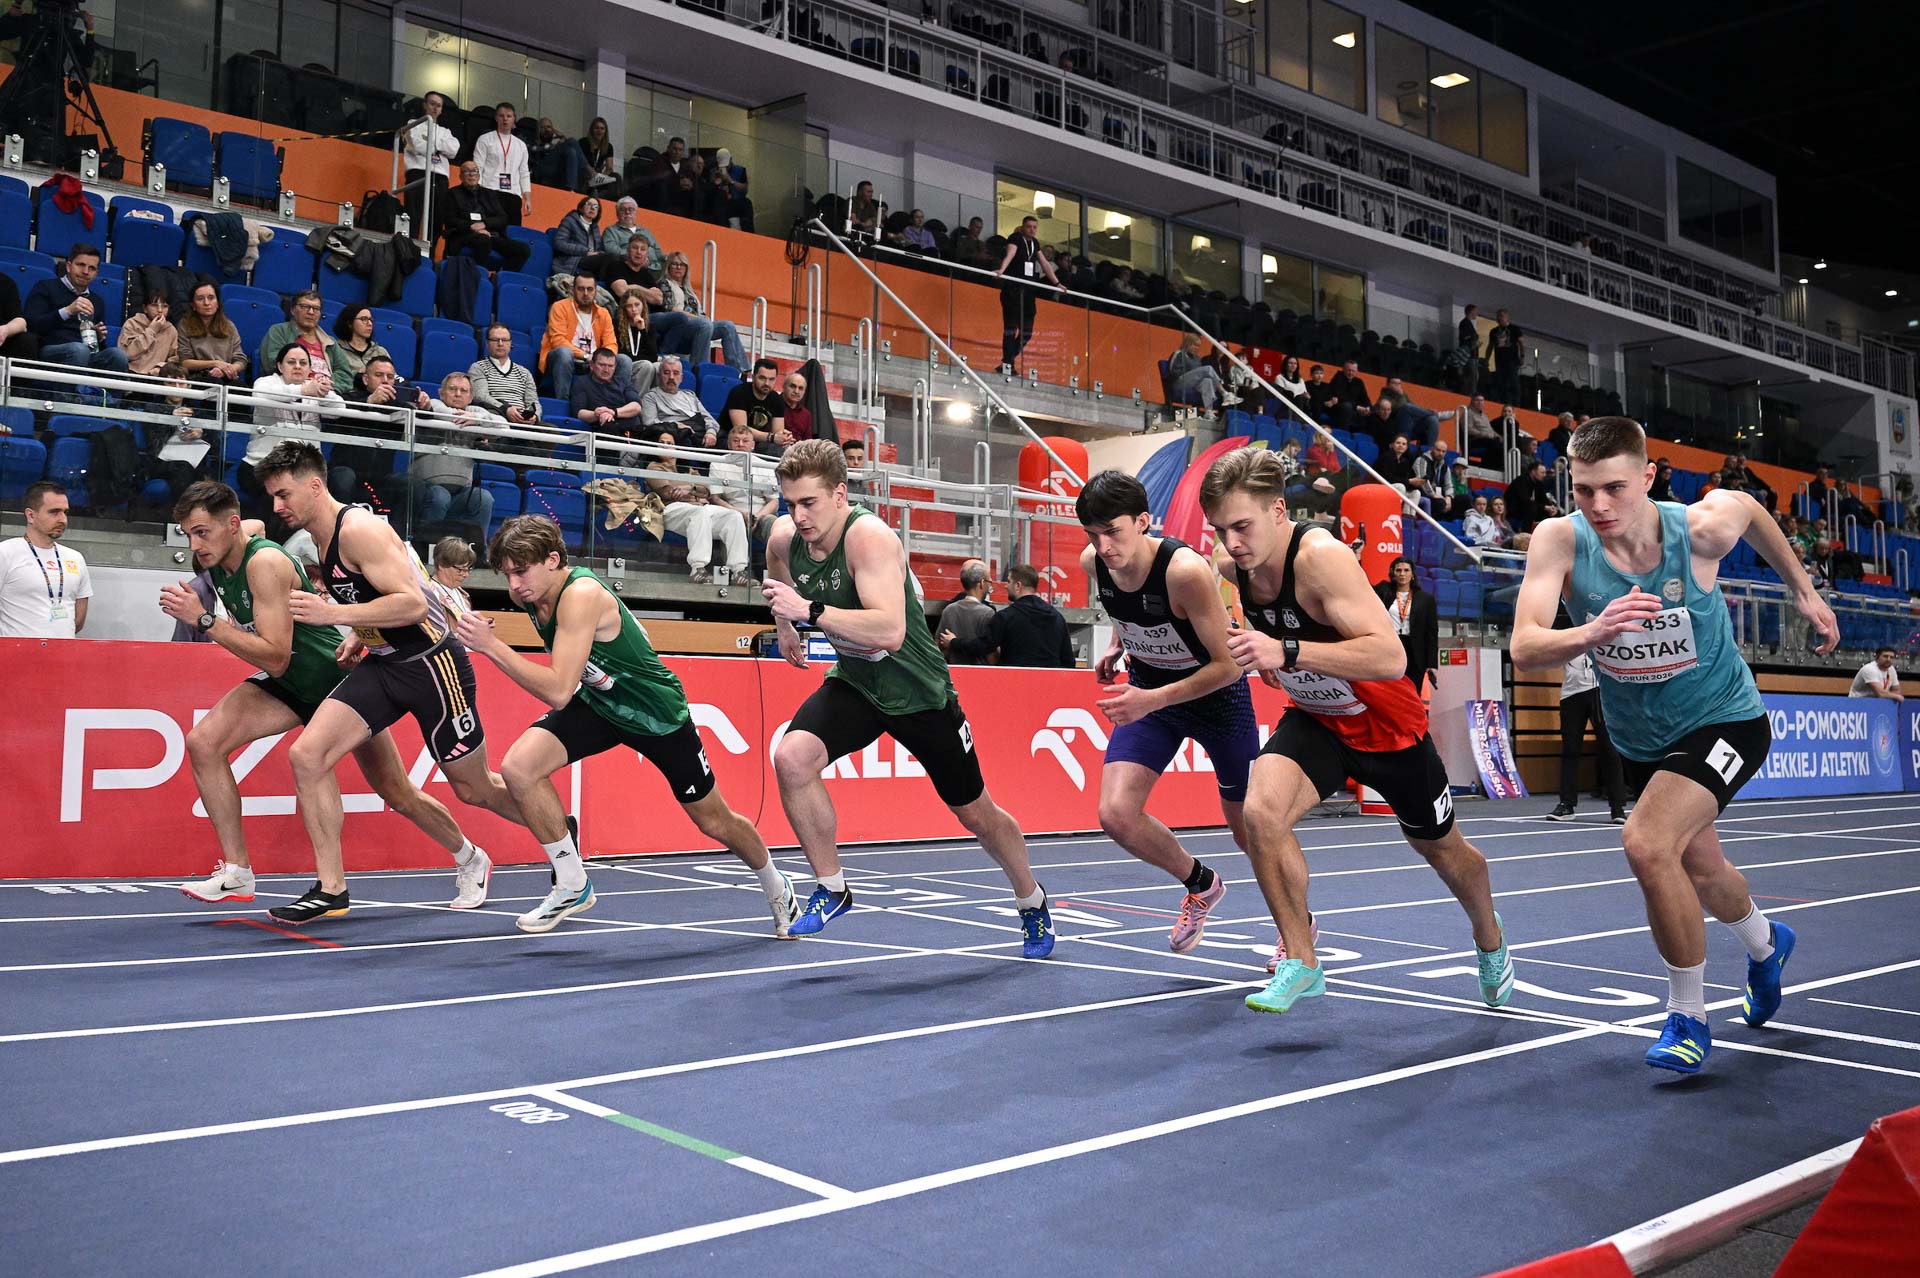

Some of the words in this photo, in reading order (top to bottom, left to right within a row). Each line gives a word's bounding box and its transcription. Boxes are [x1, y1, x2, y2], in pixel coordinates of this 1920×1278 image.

[1035, 504, 1077, 517] ORLE
[1642, 613, 1680, 632] 453
[738, 637, 749, 647] 12
[1144, 627, 1168, 639] 439
[1123, 638, 1185, 655] STAŃCZYK
[1596, 638, 1689, 661] SZOSTAK
[1293, 672, 1327, 684] 241
[1617, 674, 1649, 682] TORUŃ
[1651, 672, 1673, 681] 2026
[459, 713, 472, 733] 6
[1474, 702, 1489, 750] MISTRZ
[1483, 751, 1506, 799] POLSKI
[1721, 751, 1737, 775] 1
[1766, 752, 1817, 779] LEKKIEJ
[1820, 751, 1870, 777] ATLETYKI
[1440, 792, 1451, 820] 2
